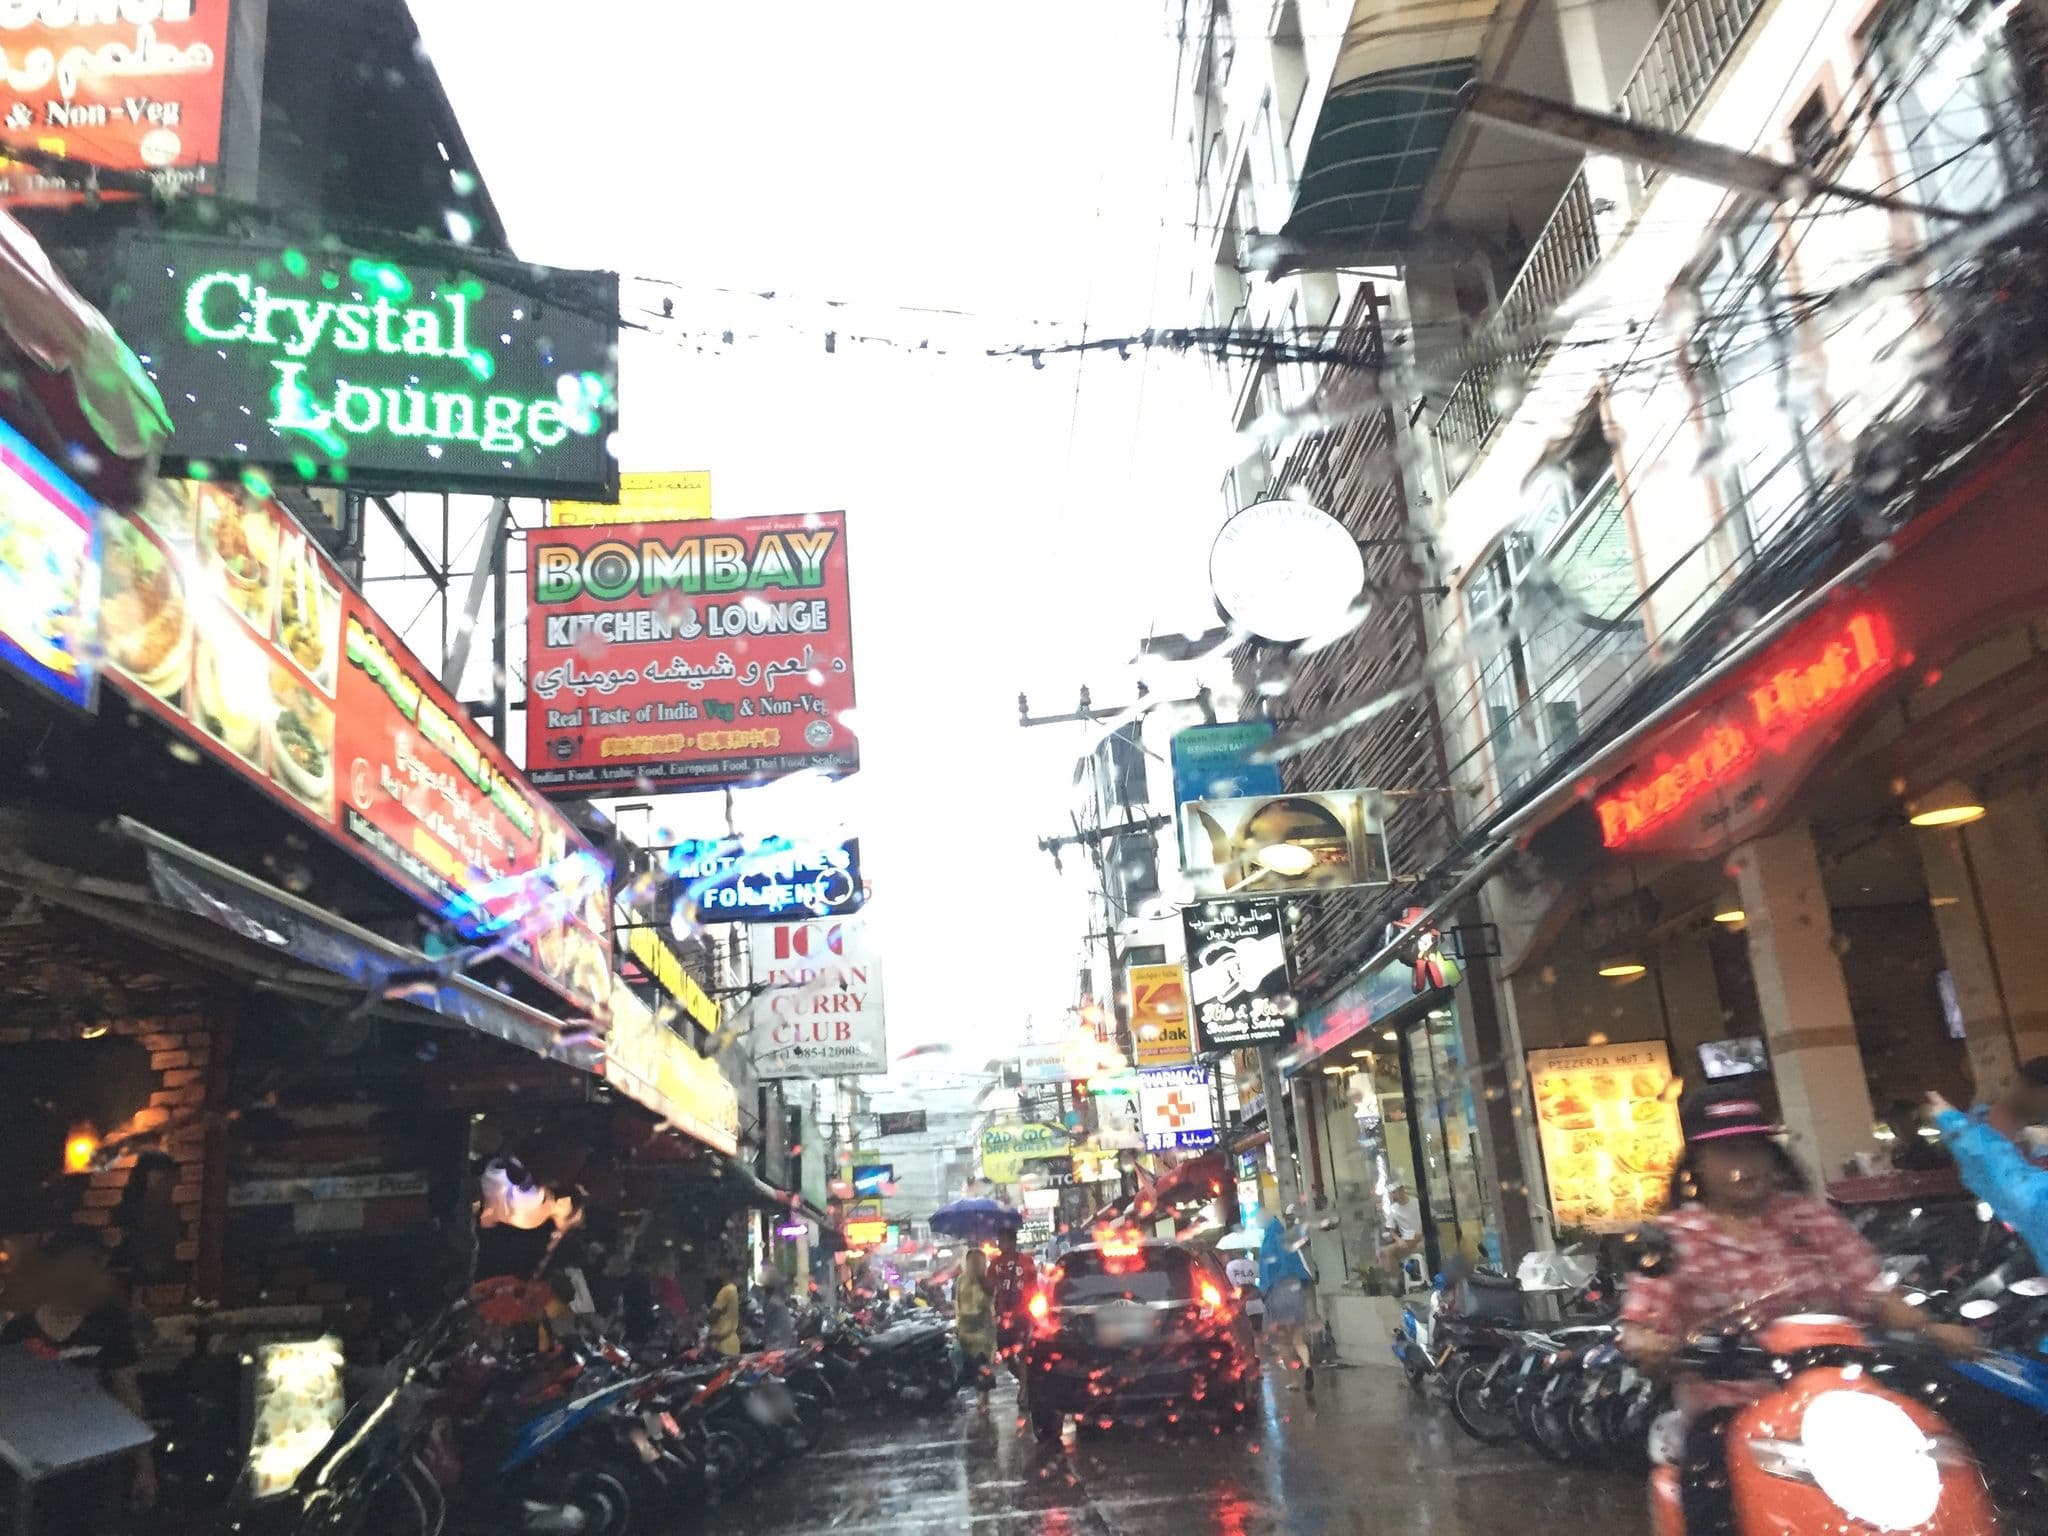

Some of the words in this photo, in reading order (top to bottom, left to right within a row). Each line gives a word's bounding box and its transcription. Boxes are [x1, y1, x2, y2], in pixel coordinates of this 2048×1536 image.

[5, 102, 34, 129] &
[46, 96, 182, 129] Non-Veg
[185, 272, 471, 357] Crystal
[268, 360, 569, 453] Lounge
[535, 532, 839, 604] BOMBAY
[545, 609, 672, 648] KITCHEN
[679, 606, 704, 641] &
[706, 599, 830, 638] LOUNGE
[547, 709, 582, 729] Real
[588, 706, 630, 726] Taste
[636, 703, 653, 723] of
[657, 701, 698, 721] India
[703, 699, 735, 723] Veg
[740, 697, 754, 717] &
[532, 771, 566, 784] Indian
[669, 763, 718, 777] European
[754, 757, 777, 769] Thai
[768, 966, 867, 987] INDIAN
[771, 992, 868, 1015] CURRY
[771, 1021, 852, 1044] CLUB
[1137, 1027, 1187, 1043] dak
[1548, 1056, 1610, 1070] PIZZERIA
[1616, 1053, 1638, 1064] HUT
[1140, 1069, 1205, 1088] PHARMACY
